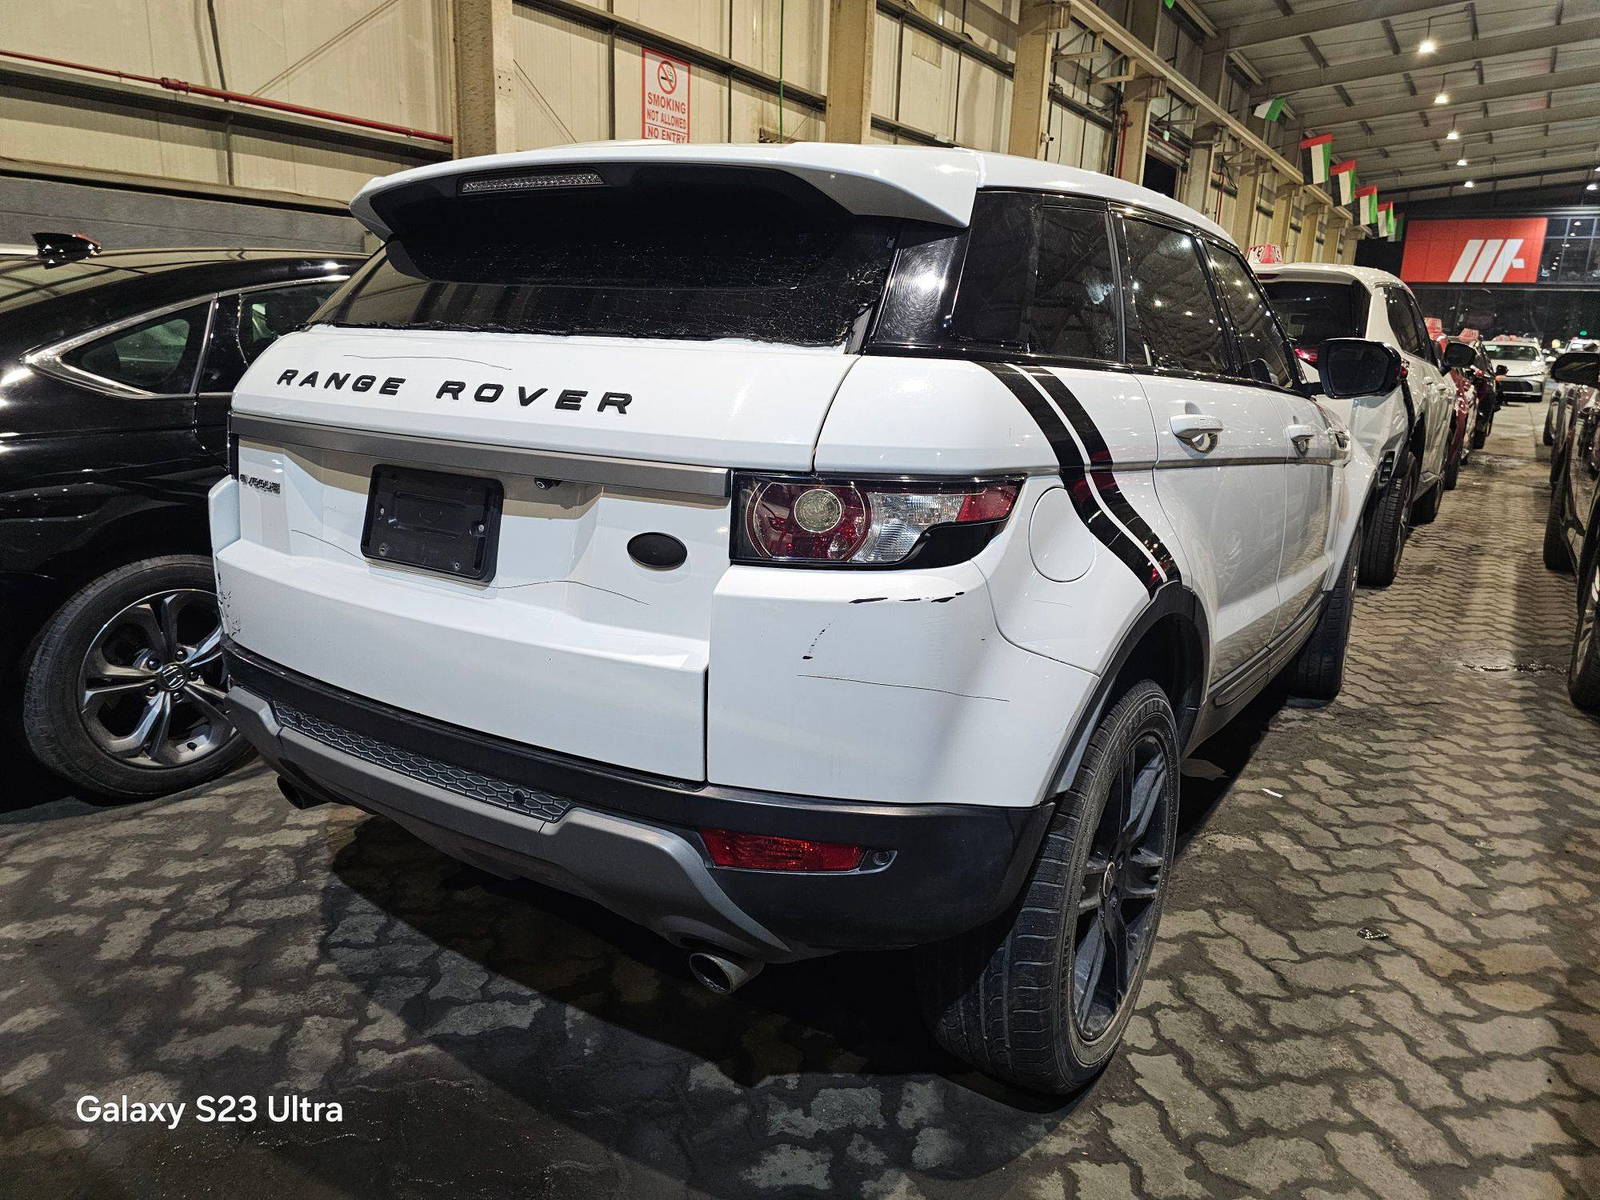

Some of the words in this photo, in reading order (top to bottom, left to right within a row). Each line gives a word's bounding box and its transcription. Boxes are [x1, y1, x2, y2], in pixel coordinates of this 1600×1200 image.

[647, 92, 686, 113] SMOKING
[646, 109, 659, 122] NOT
[660, 112, 687, 130] ALLOWED
[647, 126, 659, 139] NO
[661, 130, 686, 144] ENTRY
[276, 368, 406, 396] RANGE
[435, 380, 633, 415] ROVER
